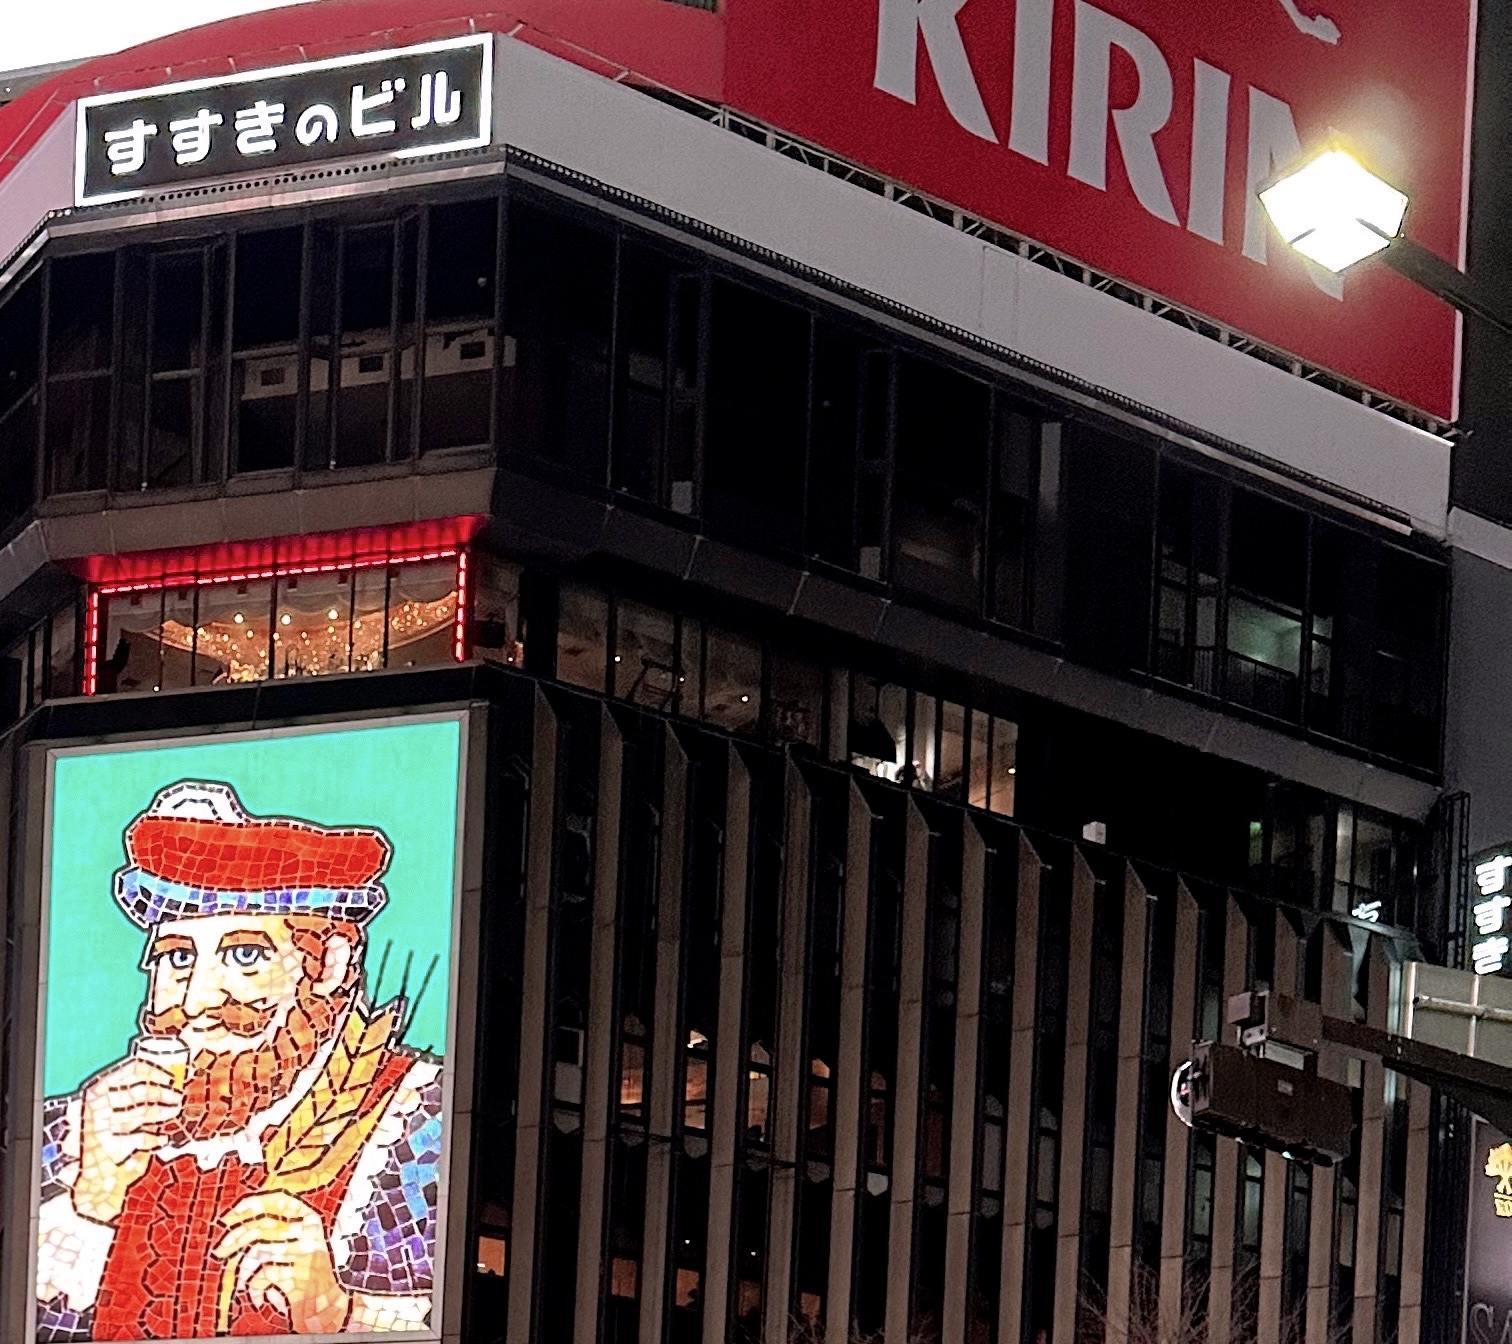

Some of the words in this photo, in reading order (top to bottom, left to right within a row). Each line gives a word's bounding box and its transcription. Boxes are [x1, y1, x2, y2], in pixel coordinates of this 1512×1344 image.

[104, 70, 464, 176] すすきのビル
